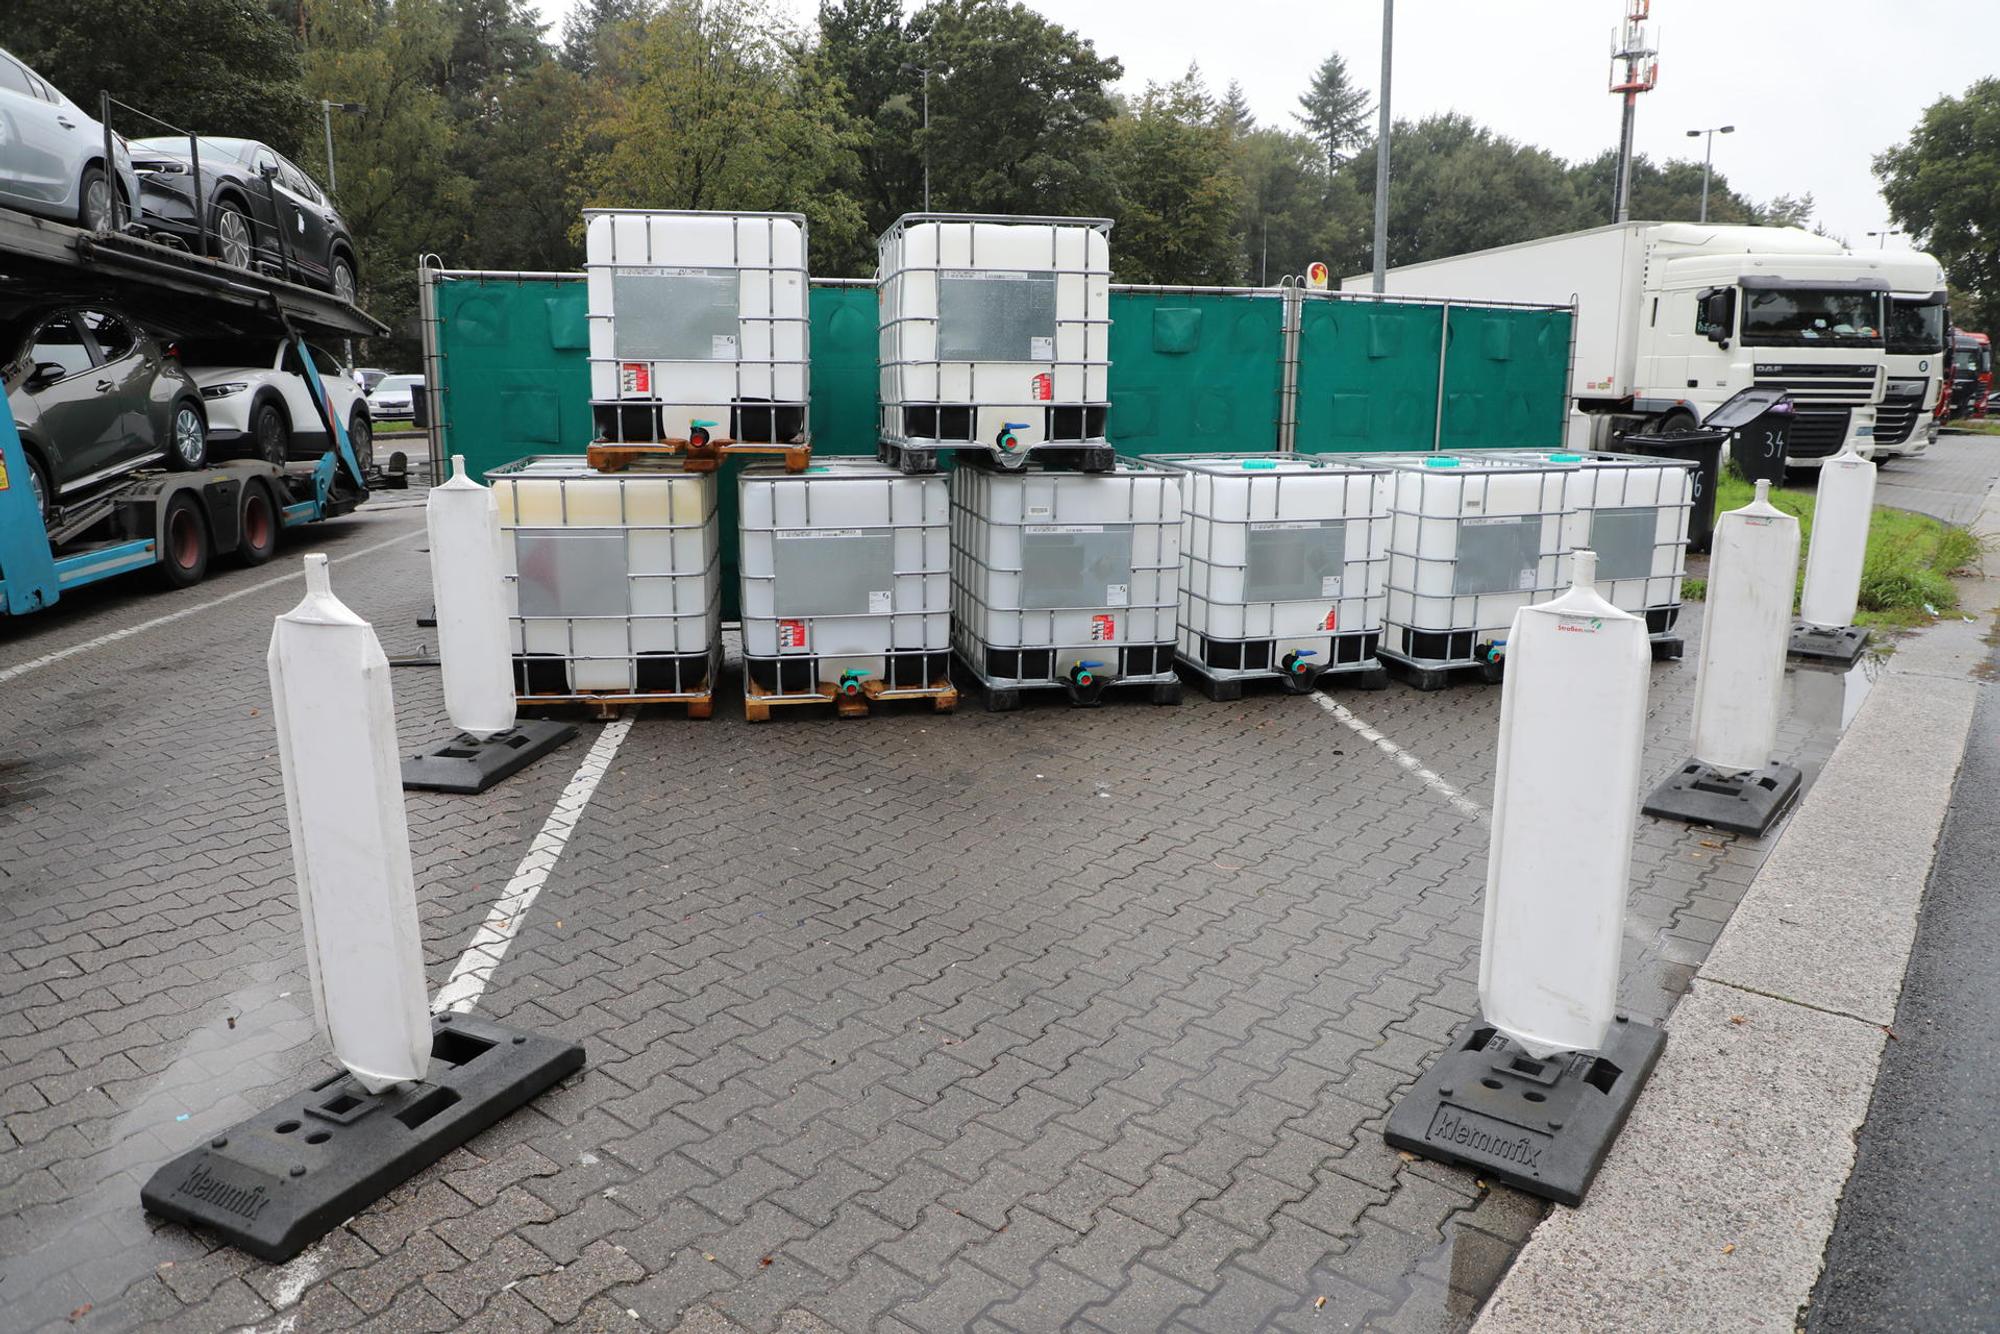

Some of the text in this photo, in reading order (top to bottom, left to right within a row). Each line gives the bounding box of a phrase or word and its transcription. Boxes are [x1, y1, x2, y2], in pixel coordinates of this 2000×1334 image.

[1764, 431, 1784, 458] 34
[1435, 1113, 1542, 1168] klemmfix
[177, 1163, 271, 1221] klemmfix
